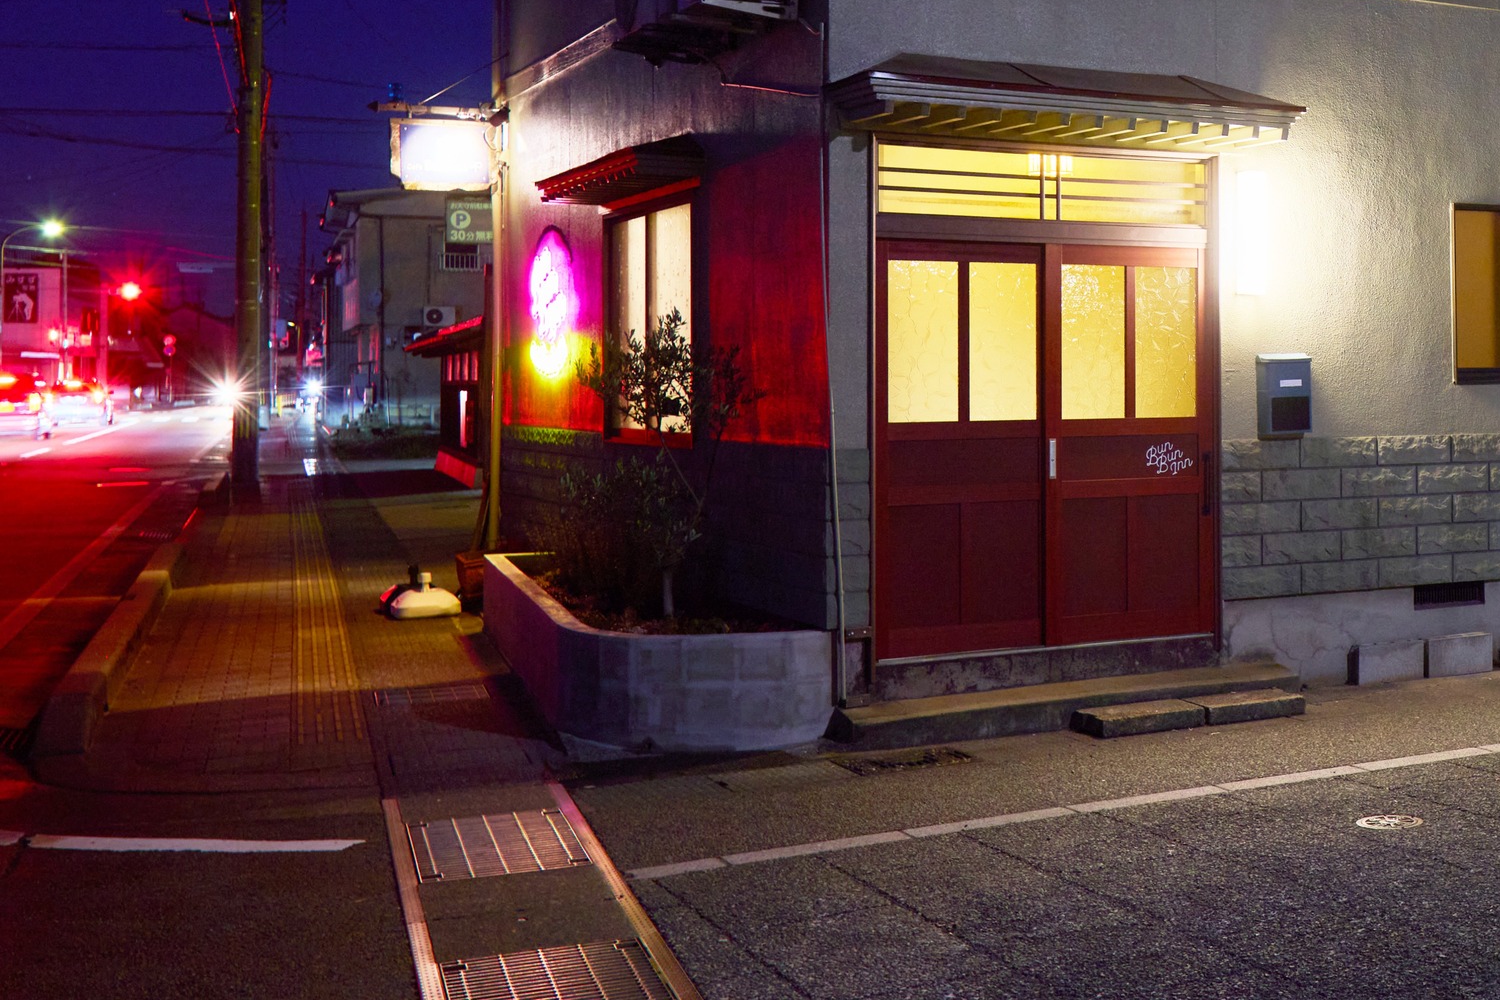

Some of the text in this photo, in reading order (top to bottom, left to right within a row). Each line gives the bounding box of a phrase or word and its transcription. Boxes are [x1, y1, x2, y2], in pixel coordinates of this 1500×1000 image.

[1145, 441, 1174, 467] Bun
[1156, 449, 1184, 475] Bun
[1169, 457, 1194, 476] Inn
